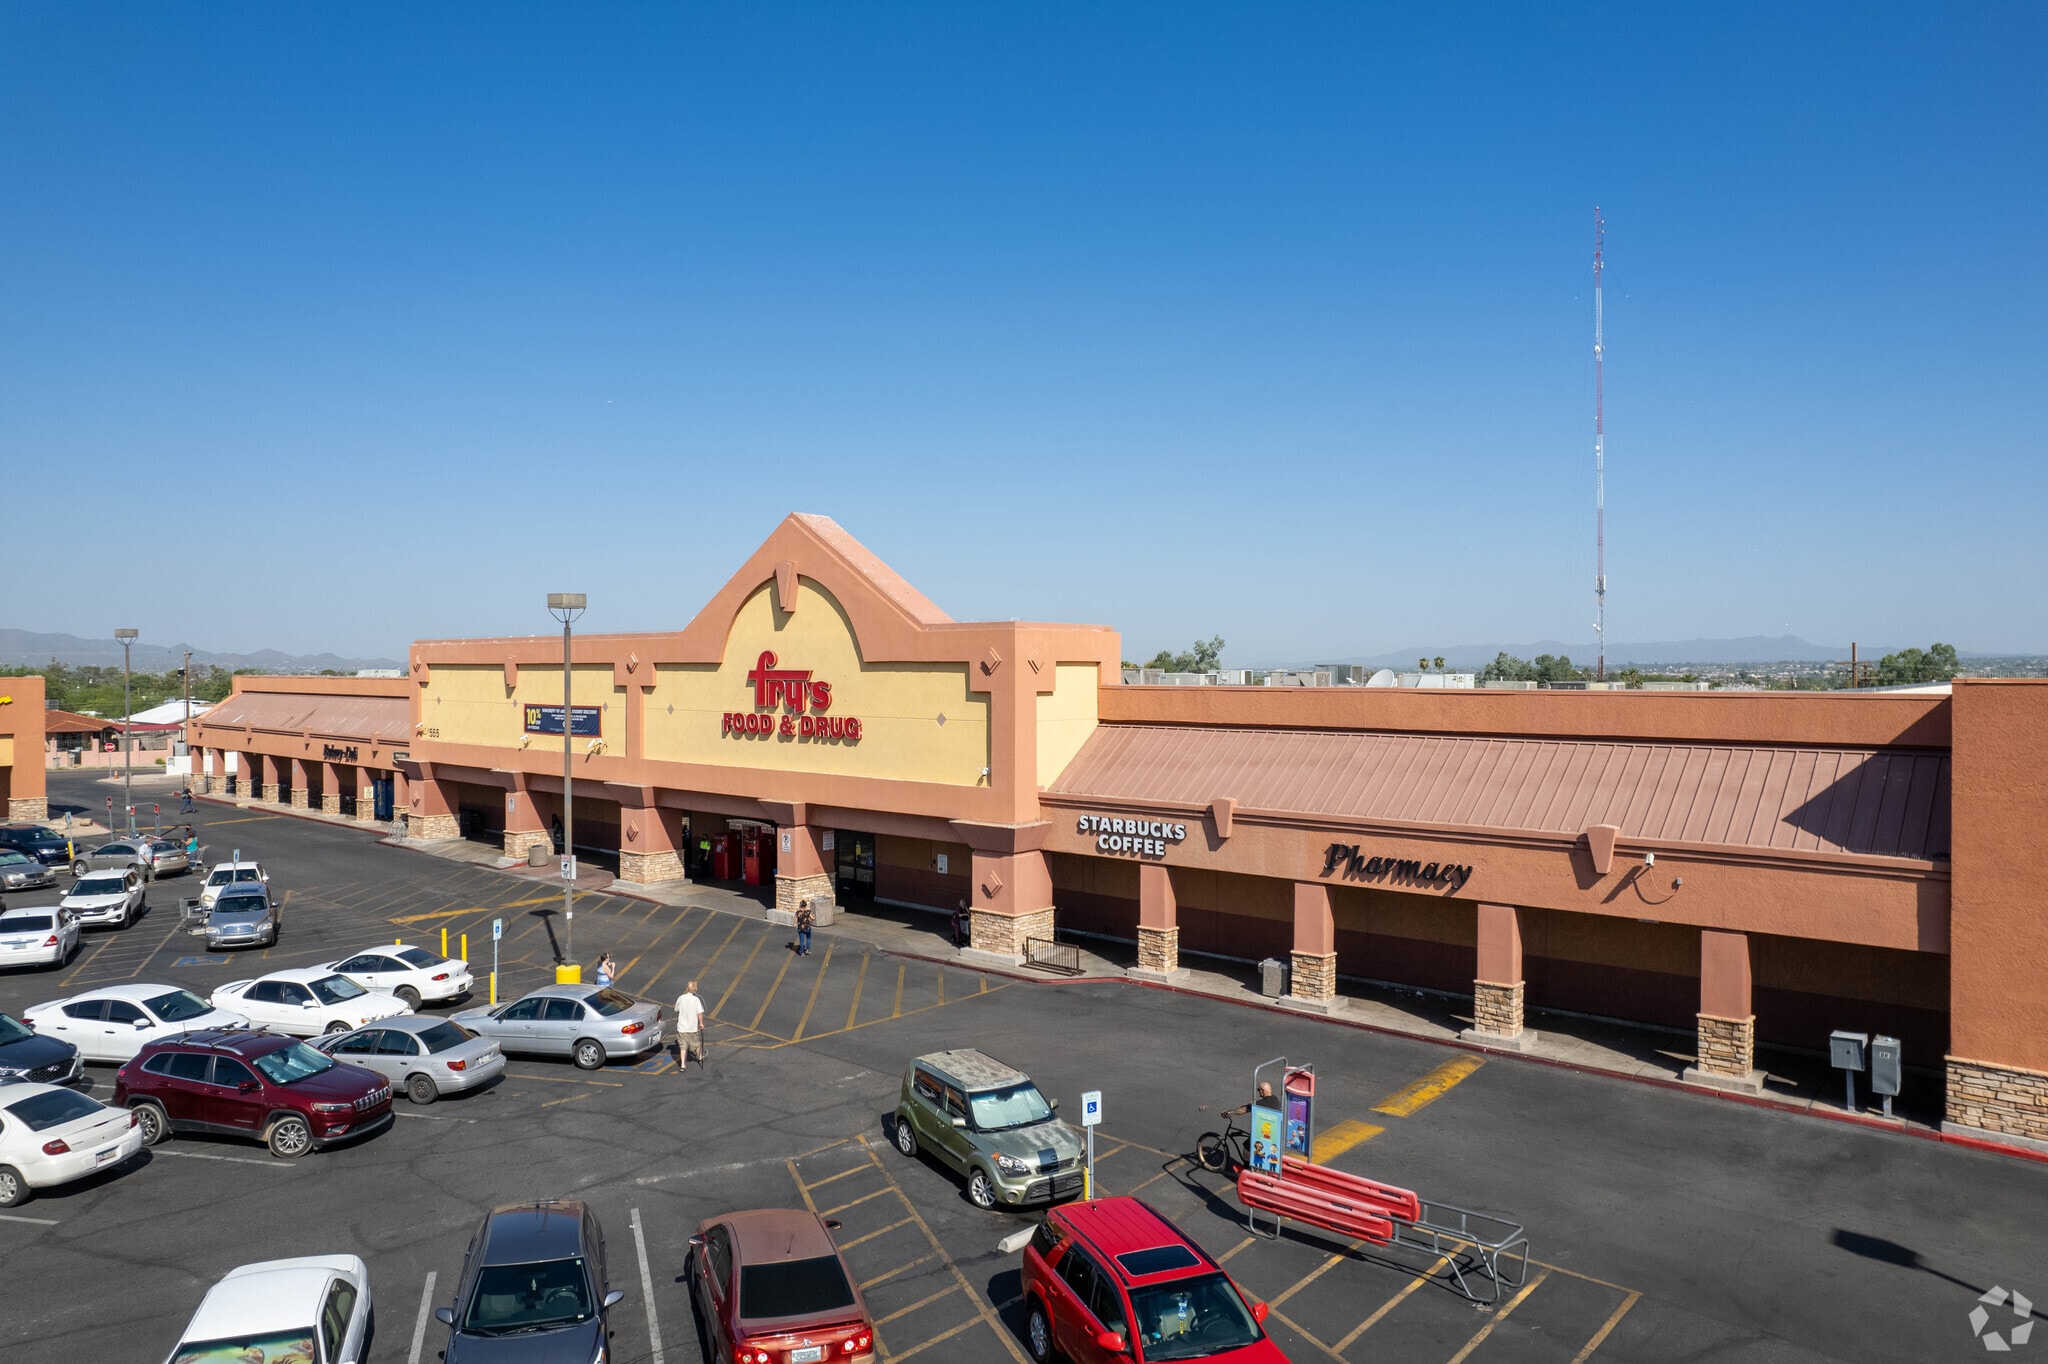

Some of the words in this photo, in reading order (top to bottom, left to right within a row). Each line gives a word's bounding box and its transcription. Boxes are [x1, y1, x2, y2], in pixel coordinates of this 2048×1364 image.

[748, 650, 832, 714] fry's
[723, 712, 776, 735] FOOD
[779, 714, 797, 736] &
[800, 715, 863, 740] DRUG
[1079, 815, 1186, 840] STARBUCKS
[1098, 834, 1165, 856] COFFEE
[1324, 843, 1473, 890] Pharmacy
